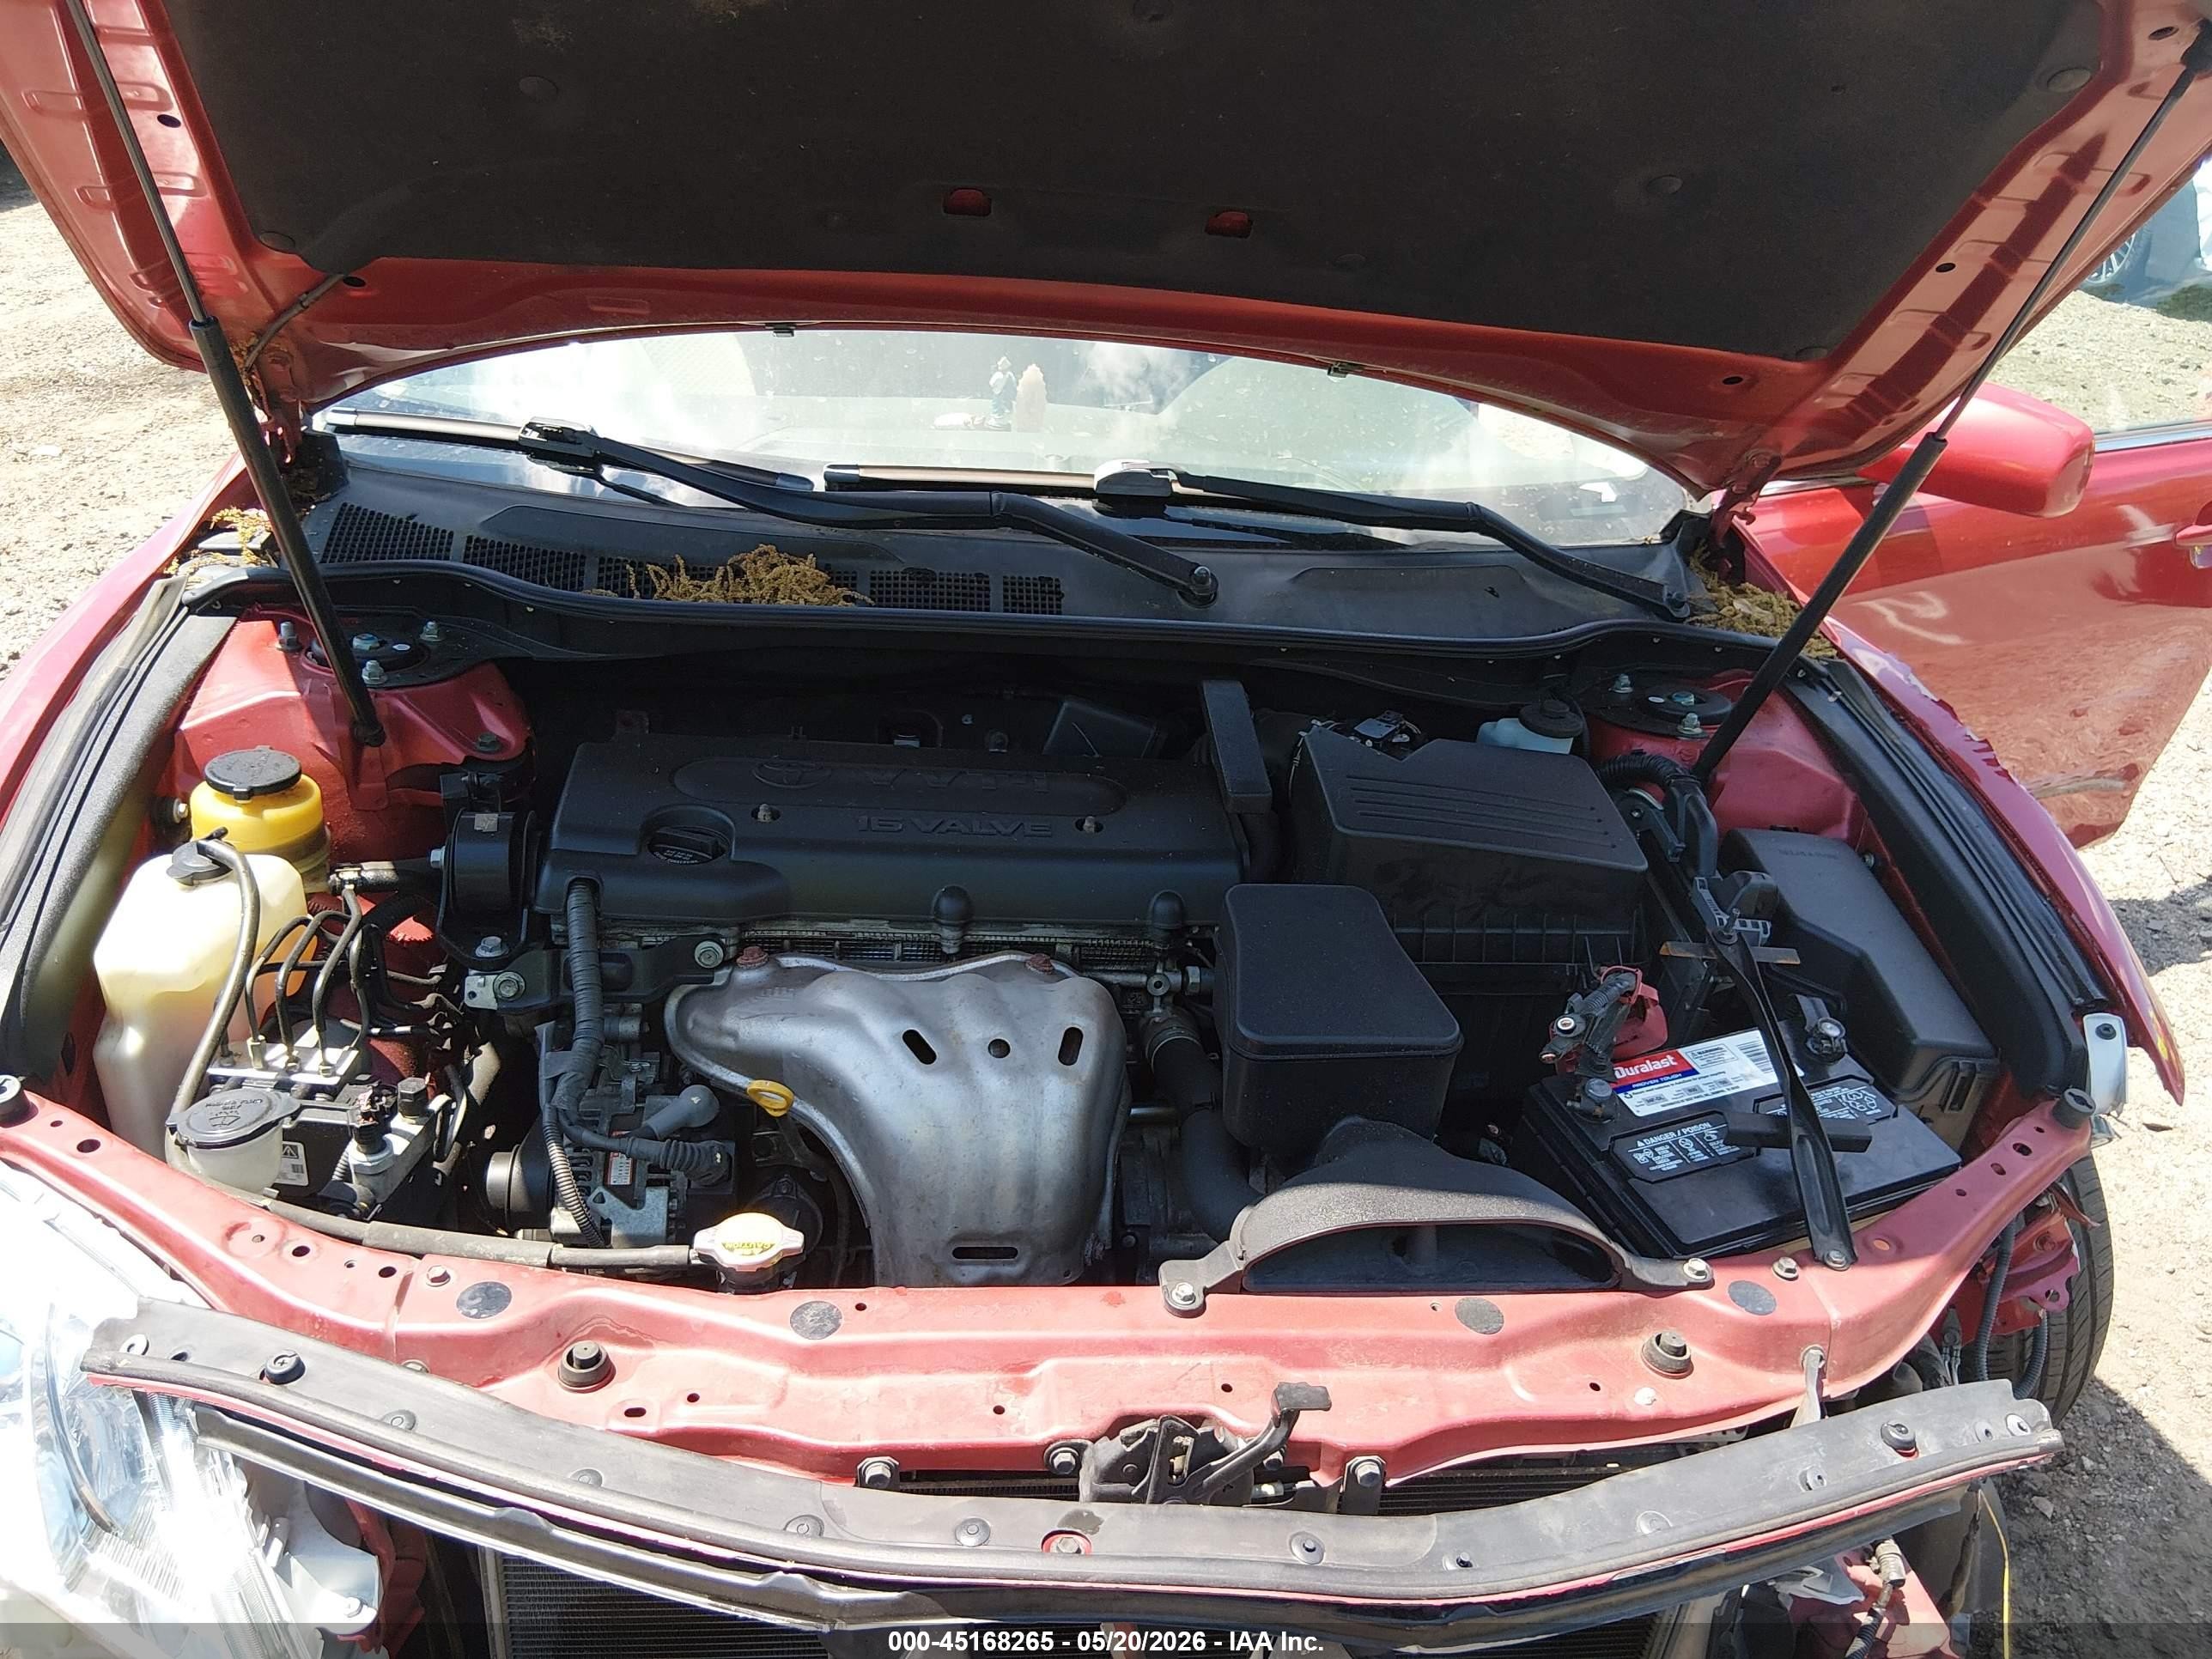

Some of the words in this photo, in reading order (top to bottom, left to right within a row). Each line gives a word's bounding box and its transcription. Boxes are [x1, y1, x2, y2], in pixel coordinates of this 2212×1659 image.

[858, 816, 904, 833] 16
[911, 818, 1053, 838] VALVE
[1613, 1054, 1678, 1079] Duralast
[1632, 1079, 1659, 1089] PROVEN
[1659, 1073, 1682, 1082] TOUGH
[1643, 1130, 1677, 1146] DANGER
[1682, 1121, 1712, 1135] POISON
